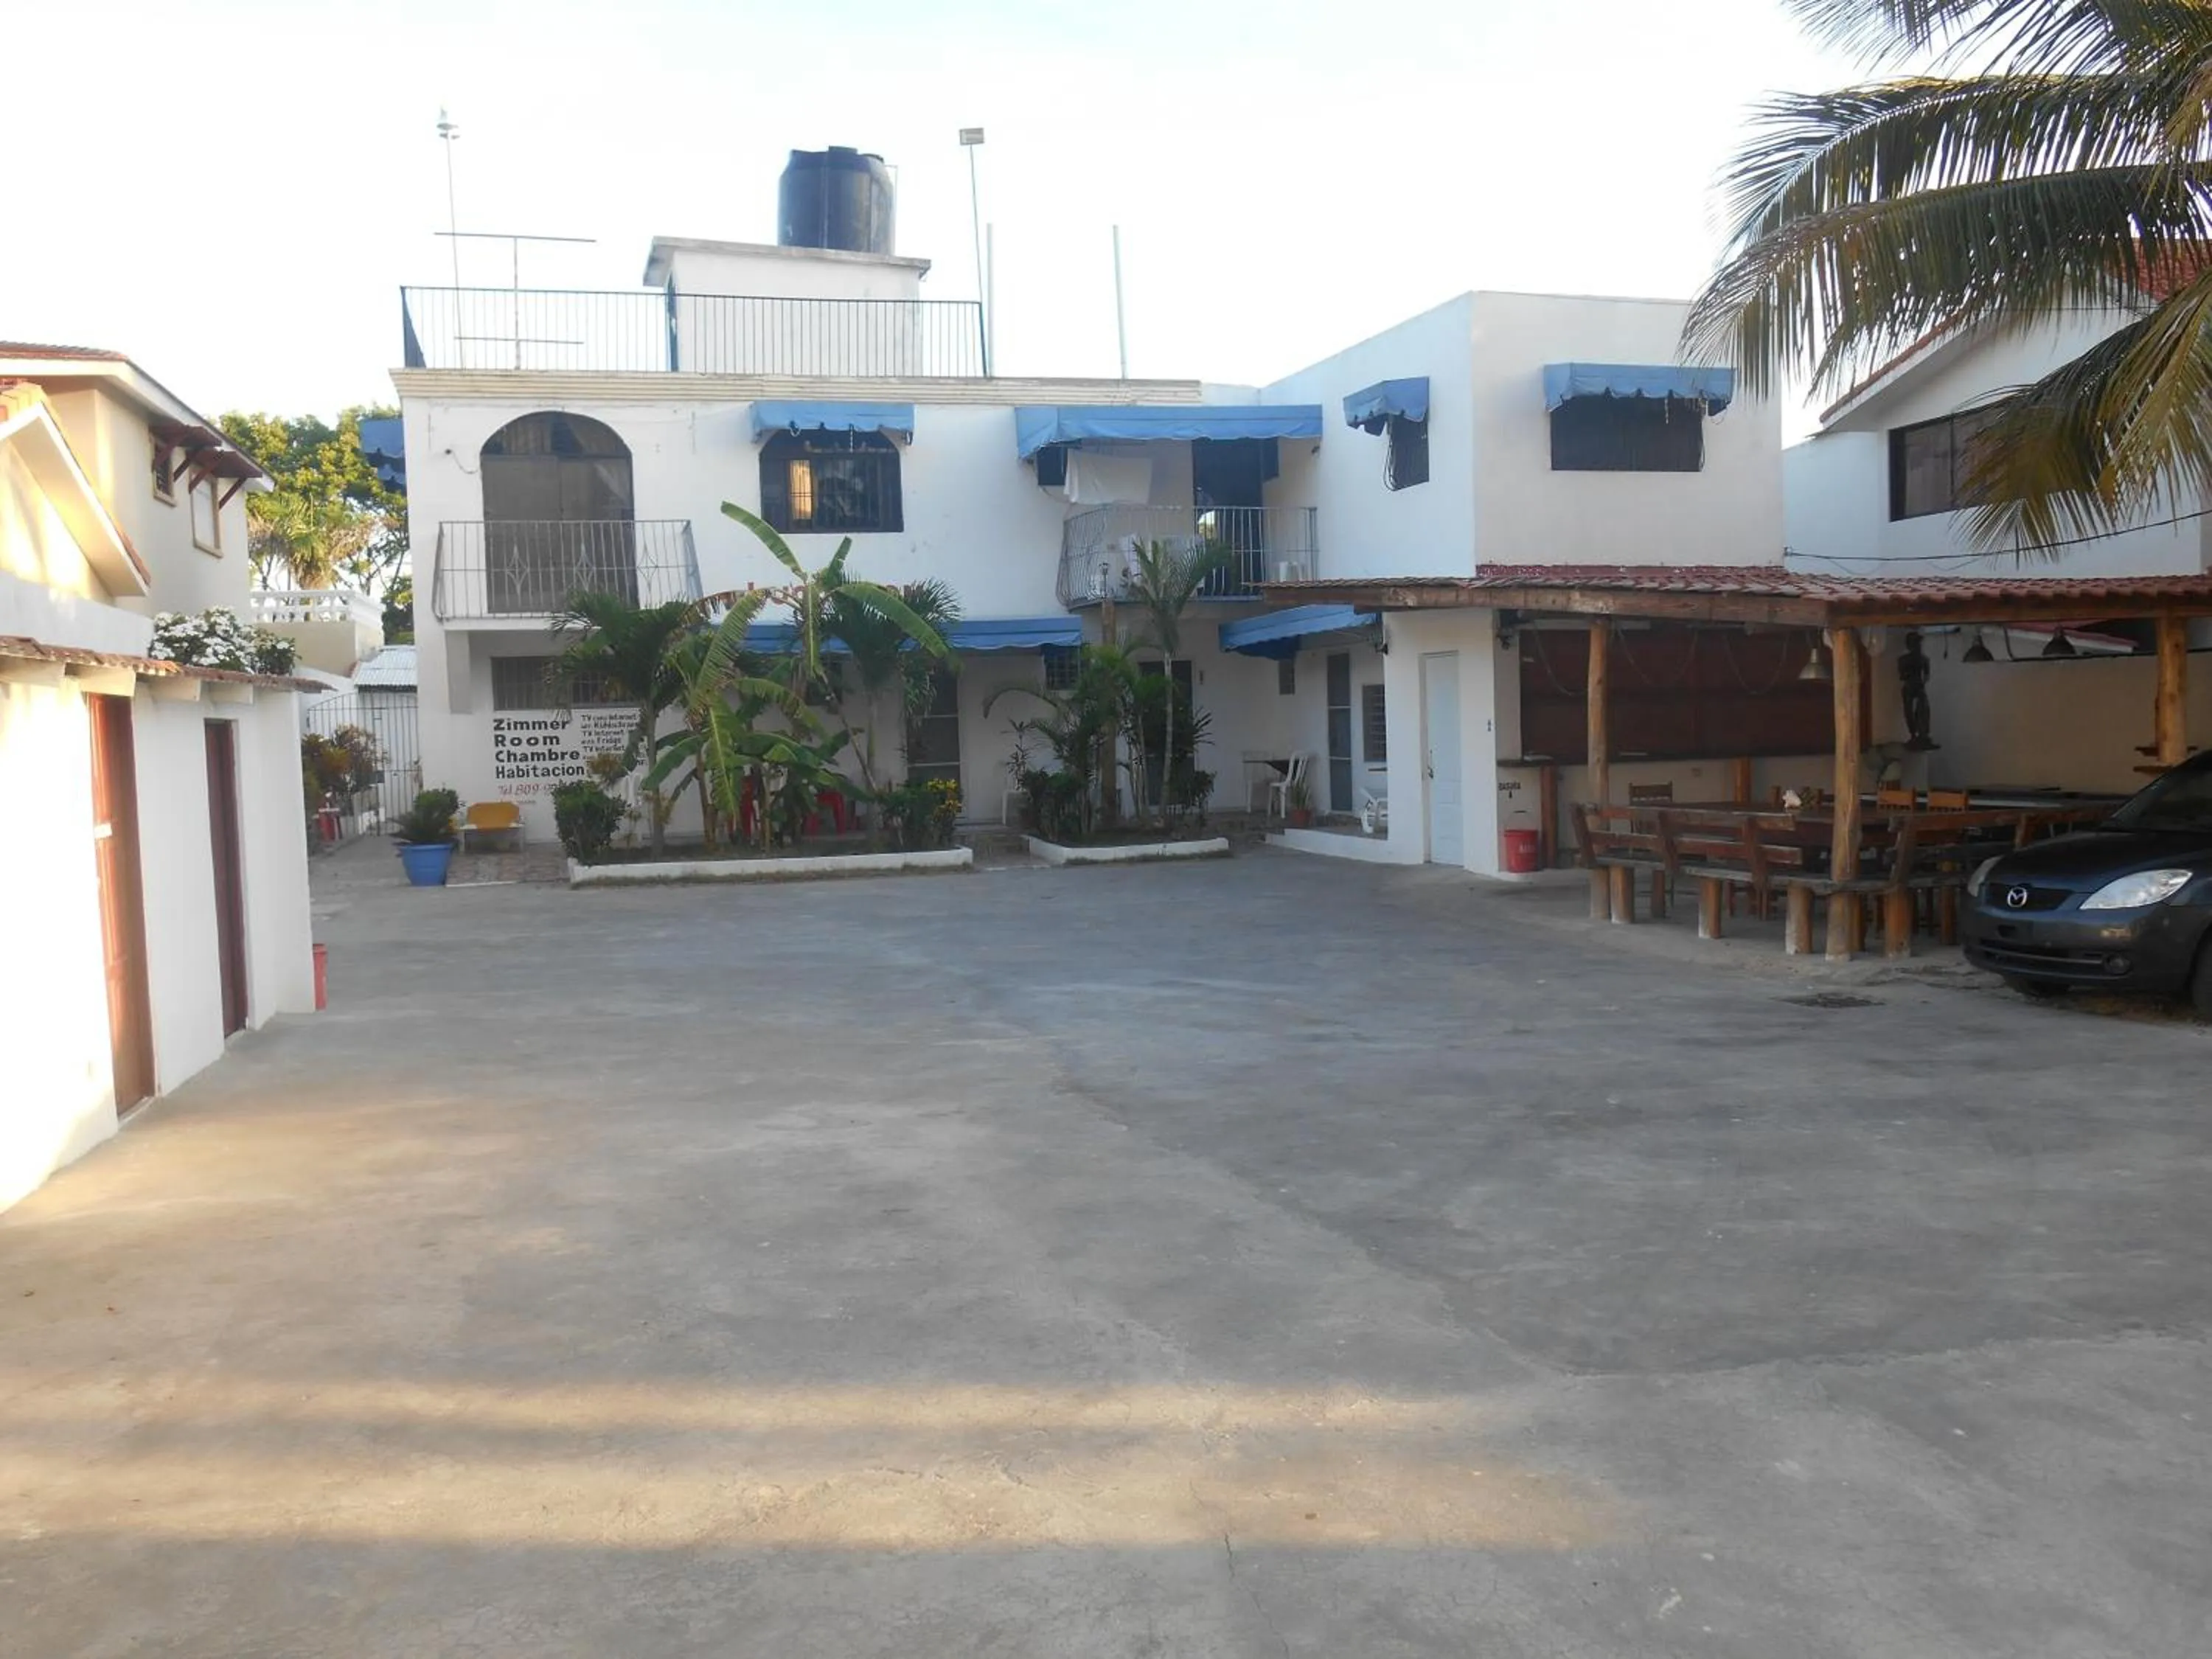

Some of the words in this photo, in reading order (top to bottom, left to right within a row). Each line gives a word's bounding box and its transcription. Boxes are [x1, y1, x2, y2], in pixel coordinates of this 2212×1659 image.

[493, 718, 570, 731] Zimmer
[494, 734, 560, 748] Room
[495, 748, 580, 763] Chambre
[495, 763, 585, 779] Habitacion
